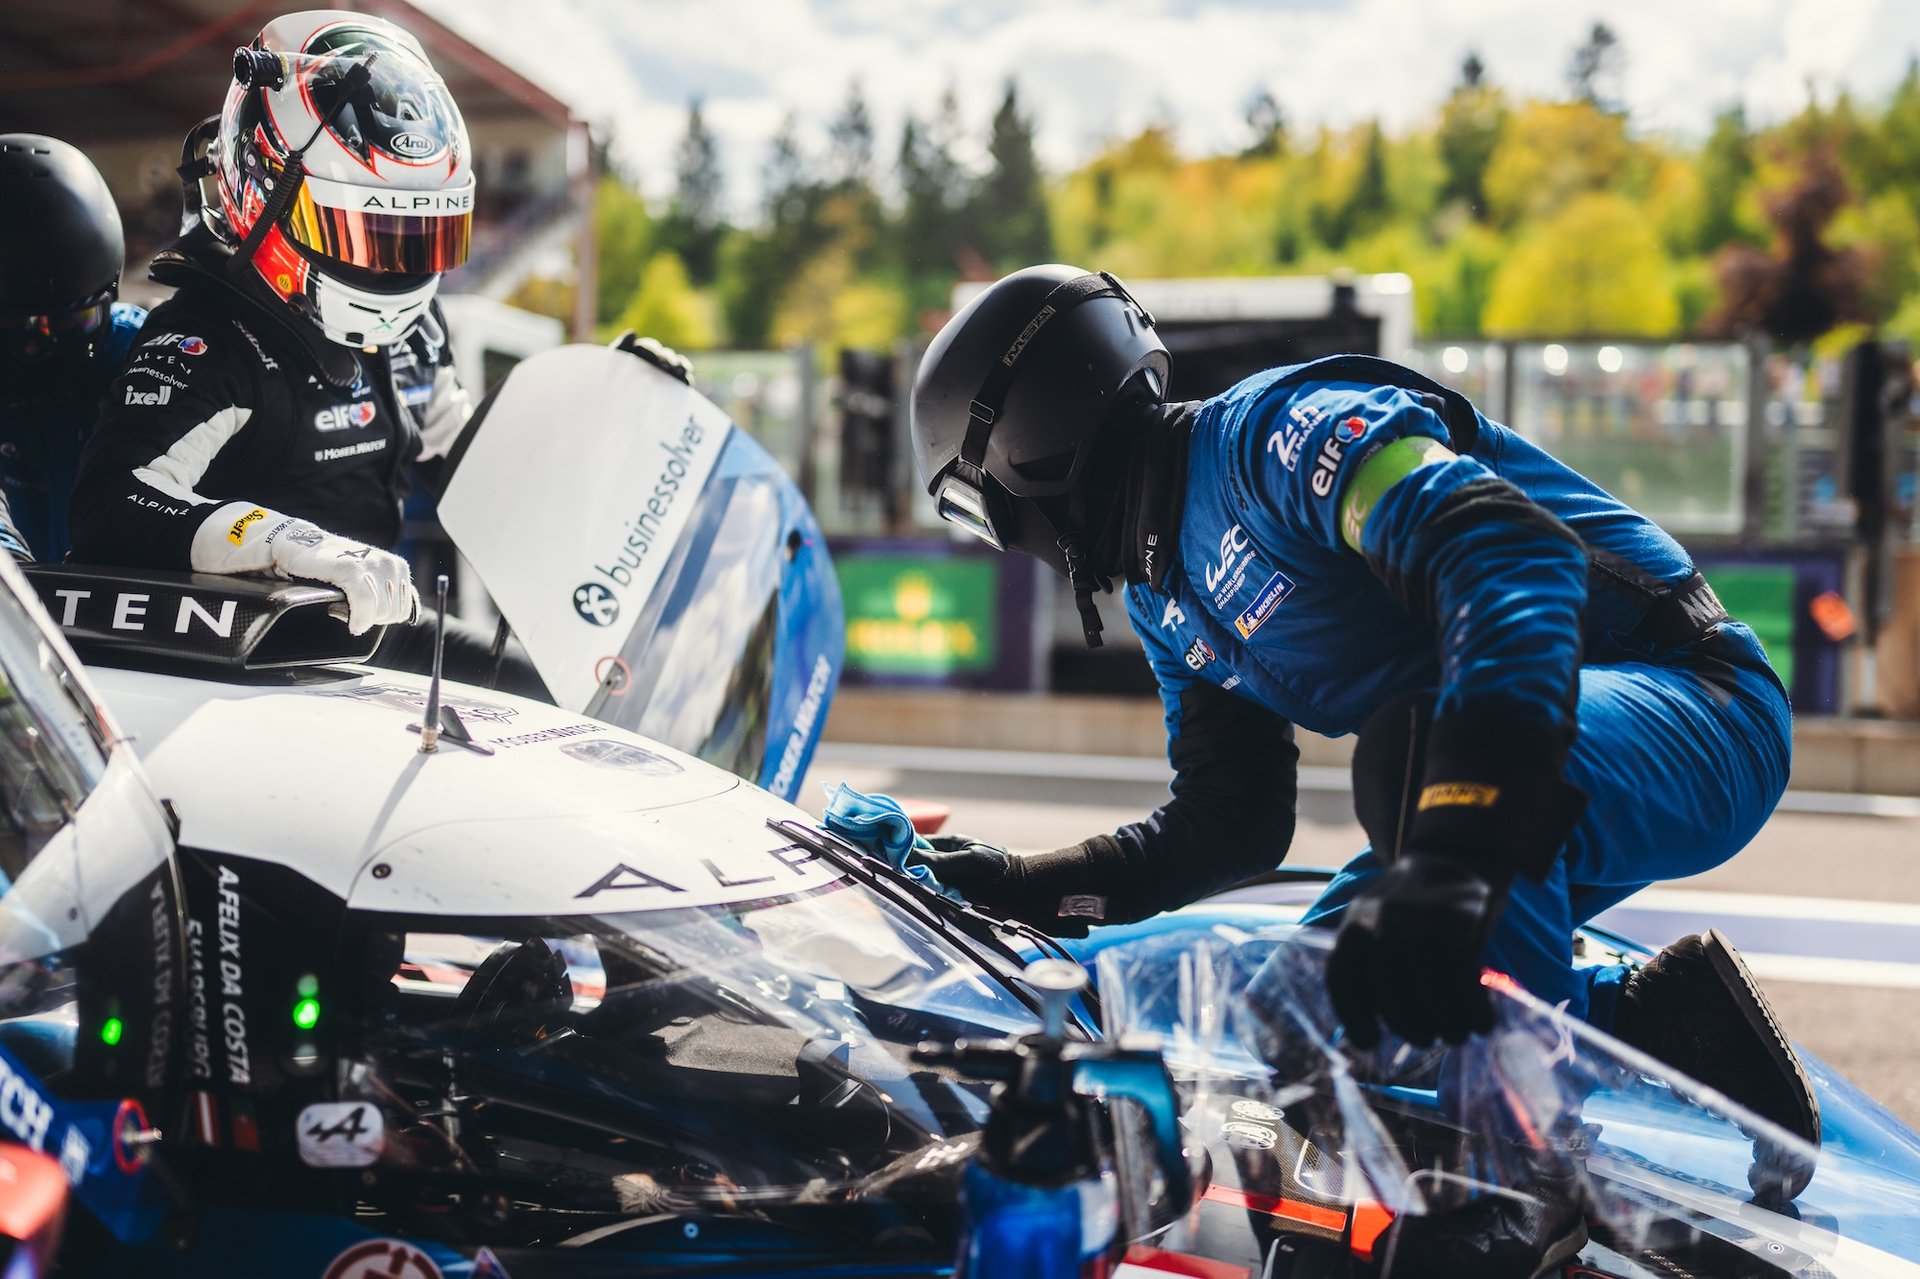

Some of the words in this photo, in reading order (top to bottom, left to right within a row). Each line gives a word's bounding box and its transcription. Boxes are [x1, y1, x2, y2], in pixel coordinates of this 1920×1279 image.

[394, 136, 429, 150] Arai
[363, 195, 469, 209] ALPINE
[124, 384, 172, 406] ixell
[1311, 437, 1344, 498] elf
[594, 414, 705, 588] businessolver
[1205, 523, 1249, 593] WEC
[55, 589, 239, 639] TEN
[1254, 581, 1286, 619] MICHELIN
[220, 959, 243, 996] DA
[222, 1002, 250, 1084] COSTA
